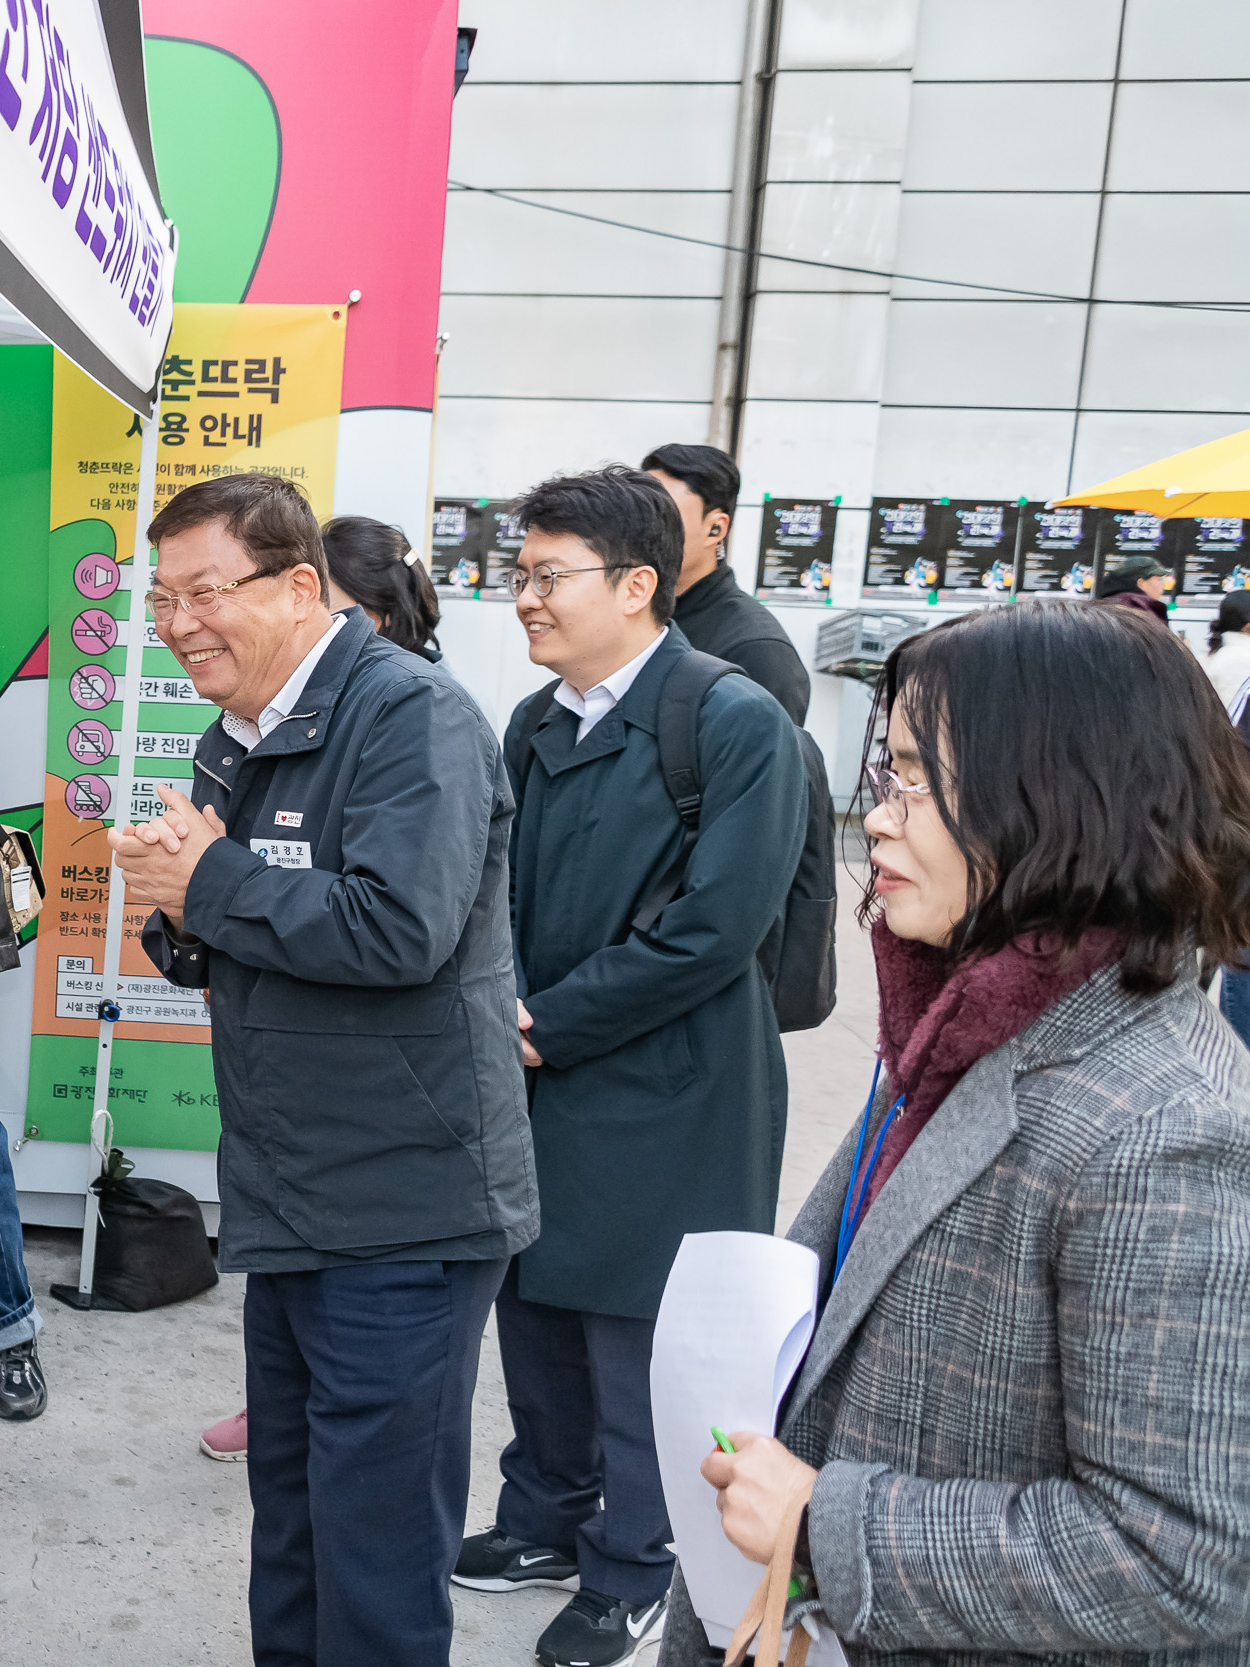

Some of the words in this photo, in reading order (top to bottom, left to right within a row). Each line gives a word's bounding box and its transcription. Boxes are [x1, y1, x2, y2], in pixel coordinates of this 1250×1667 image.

[161, 355, 287, 404] 춘뜨락
[200, 413, 263, 449] 안내
[77, 461, 134, 475] 청춘뜨락은
[174, 463, 197, 476] 함께
[108, 482, 140, 494] 안전하
[90, 498, 111, 511] 다음
[163, 683, 193, 698] 훼손
[161, 738, 190, 754] 진입
[61, 864, 110, 884] 버스킹
[59, 911, 79, 922] 장소
[82, 912, 102, 924] 사용
[59, 925, 88, 937] 반드시
[65, 959, 86, 971] 문의
[66, 980, 93, 991] 버스킹
[95, 981, 104, 991] 신
[65, 1001, 83, 1012] 시설
[126, 1005, 152, 1015] 광진구
[154, 1006, 197, 1018] 공원녹지과
[110, 1067, 124, 1080] 관
